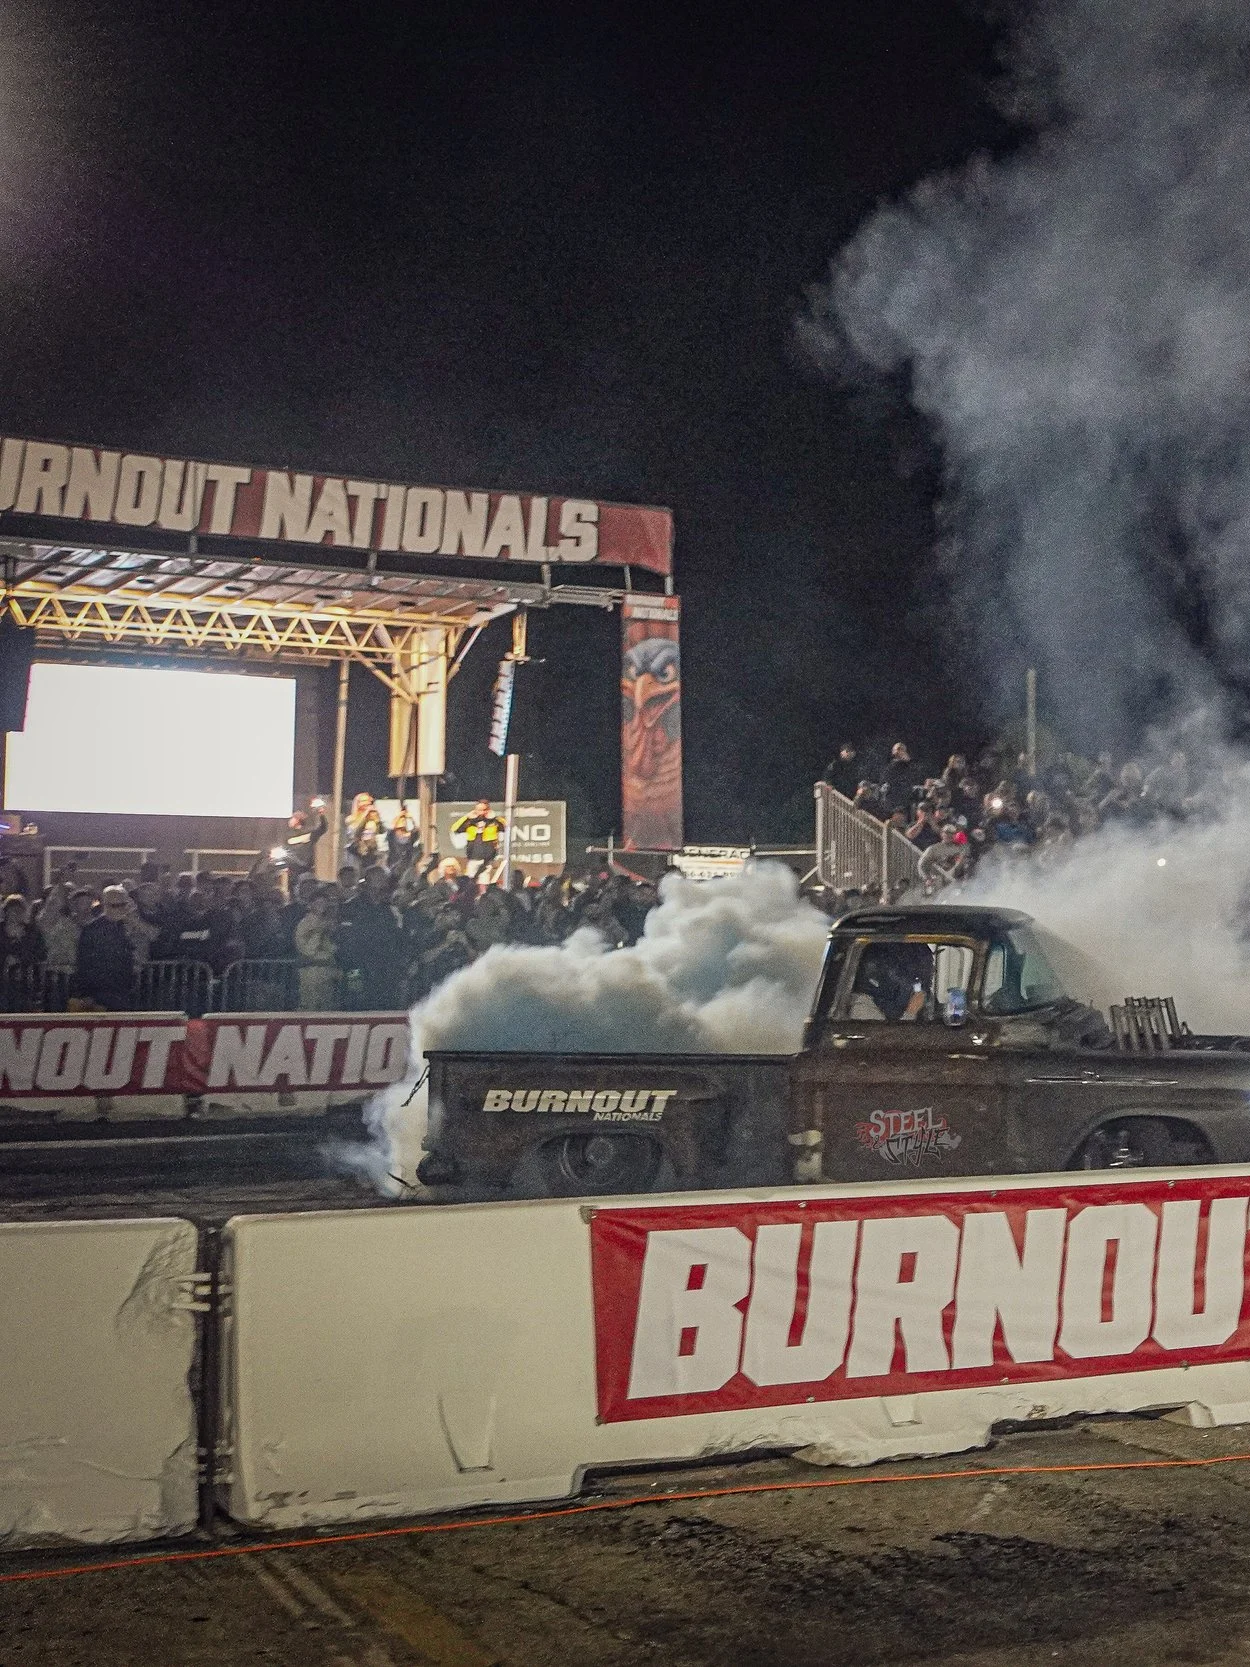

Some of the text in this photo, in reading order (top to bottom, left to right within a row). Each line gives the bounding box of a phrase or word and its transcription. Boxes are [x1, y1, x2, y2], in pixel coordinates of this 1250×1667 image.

[258, 470, 600, 564] NATIONALS
[483, 1089, 678, 1113] BURNOUT
[593, 1112, 663, 1122] NATIONALS
[869, 1106, 943, 1138] STEEL
